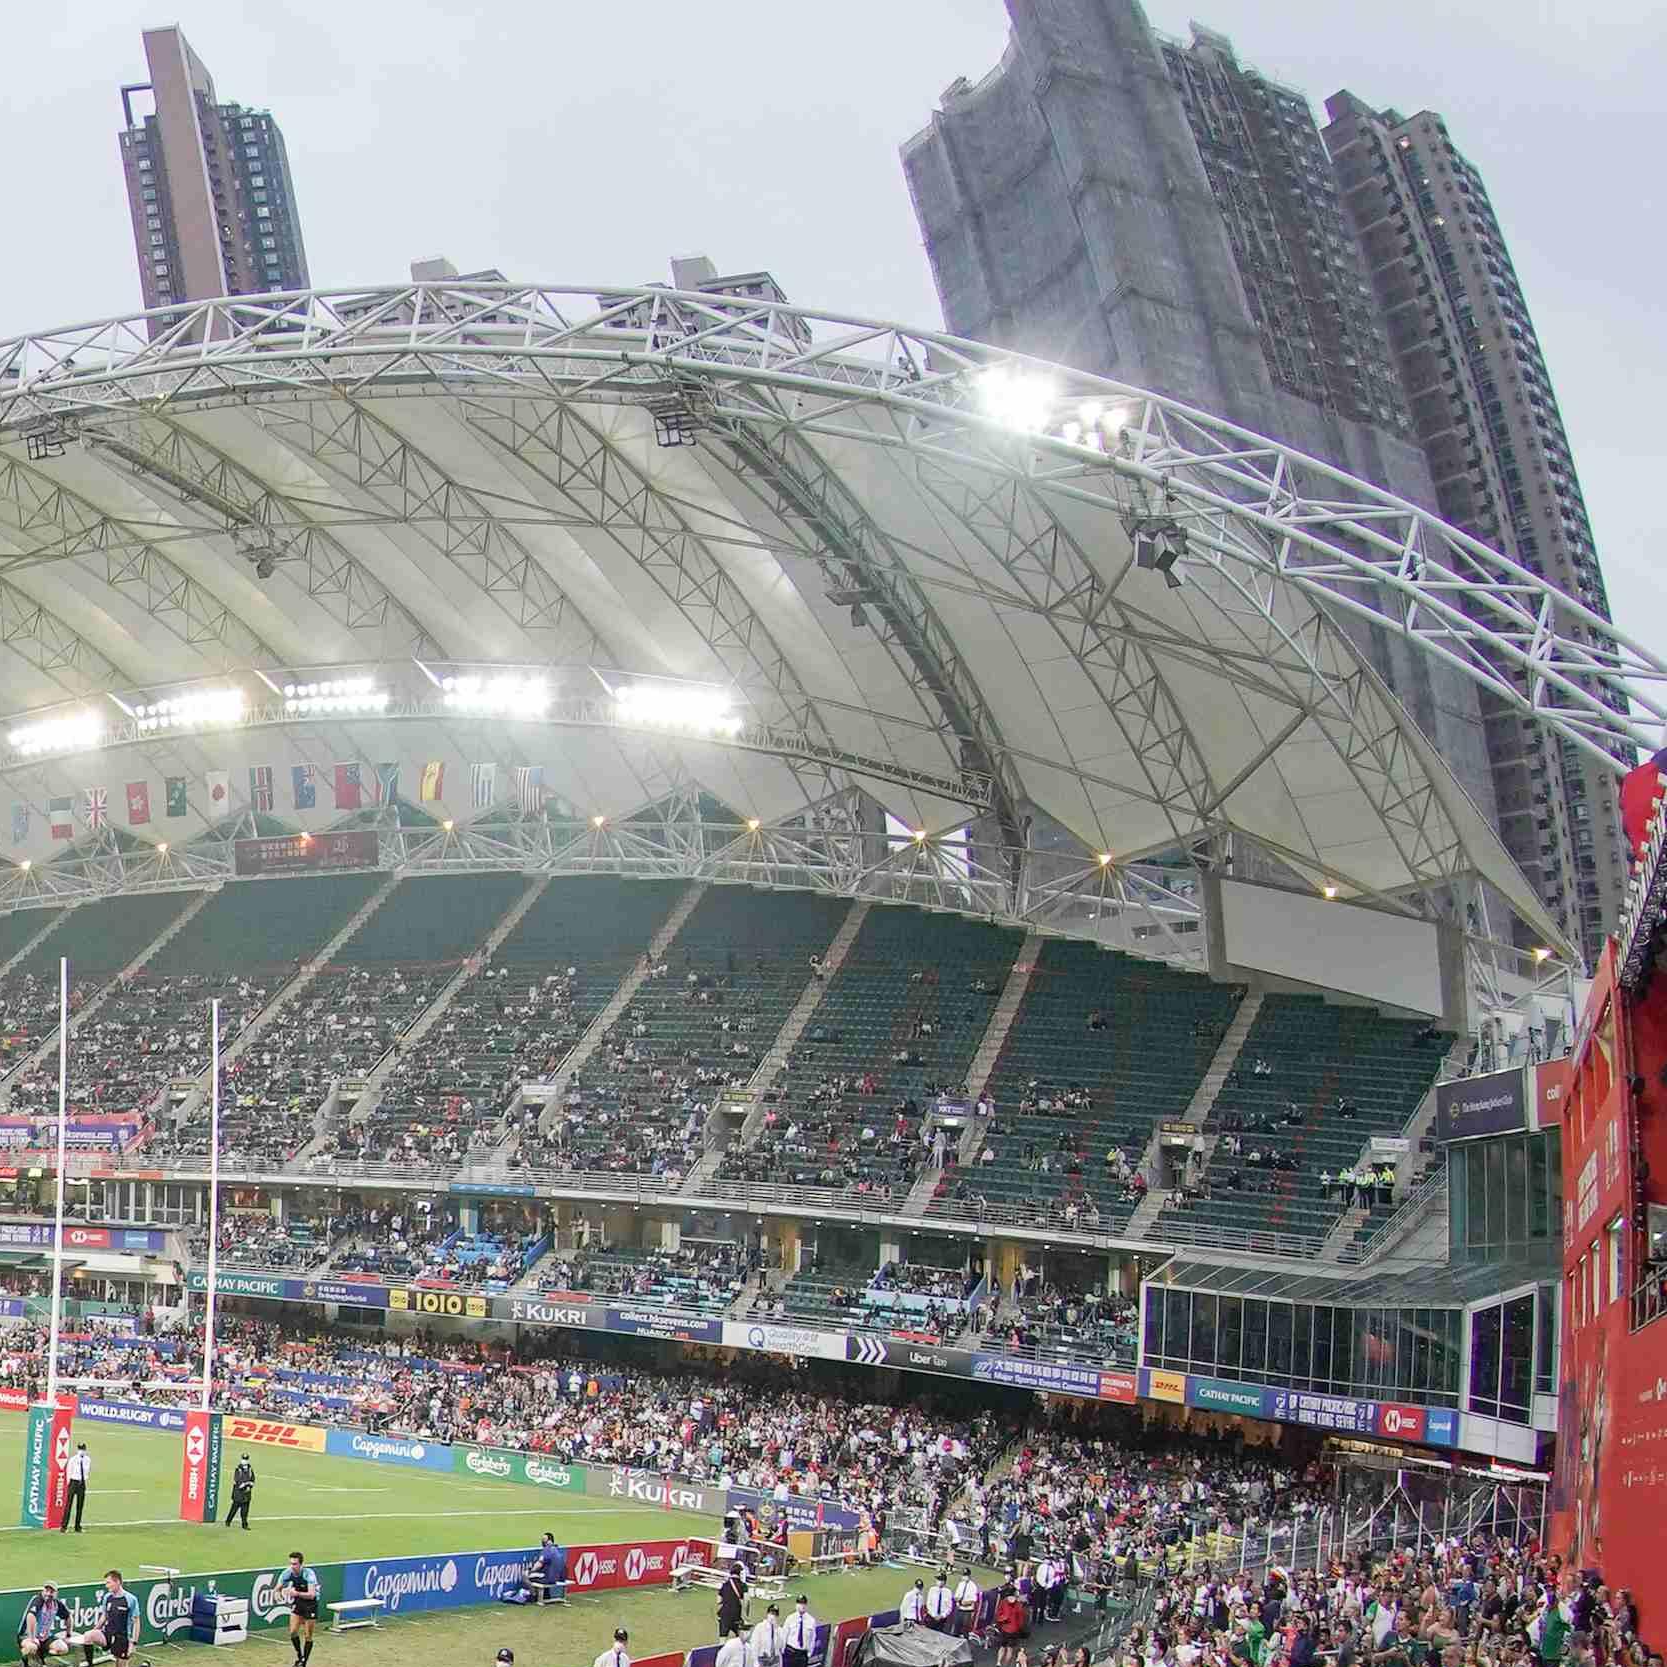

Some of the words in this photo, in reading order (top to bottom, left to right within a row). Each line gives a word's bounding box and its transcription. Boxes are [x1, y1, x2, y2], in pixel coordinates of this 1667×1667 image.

[235, 1279, 279, 1294] PACIFIC
[527, 1304, 586, 1324] KUKRI
[909, 1341, 931, 1354] Uber
[1155, 1380, 1181, 1392] DHL
[1199, 1388, 1229, 1403] CATHAY
[1230, 1393, 1259, 1407] PACIFIC
[33, 1418, 44, 1466] PACIFIC
[210, 1423, 220, 1462] PACIFIC
[231, 1419, 299, 1446] DHL
[352, 1435, 411, 1459] Capgemini
[466, 1451, 511, 1476] Carlsberg
[526, 1460, 570, 1486] Carlsberg
[28, 1466, 40, 1514] CATHAY
[55, 1471, 65, 1507] HSBC
[187, 1467, 198, 1500] HSBC
[207, 1463, 216, 1509] CATHAY
[628, 1479, 703, 1509] KUKRI
[598, 1559, 617, 1575] HSBC
[648, 1555, 664, 1570] HSBC
[365, 1562, 441, 1609] Capgemini
